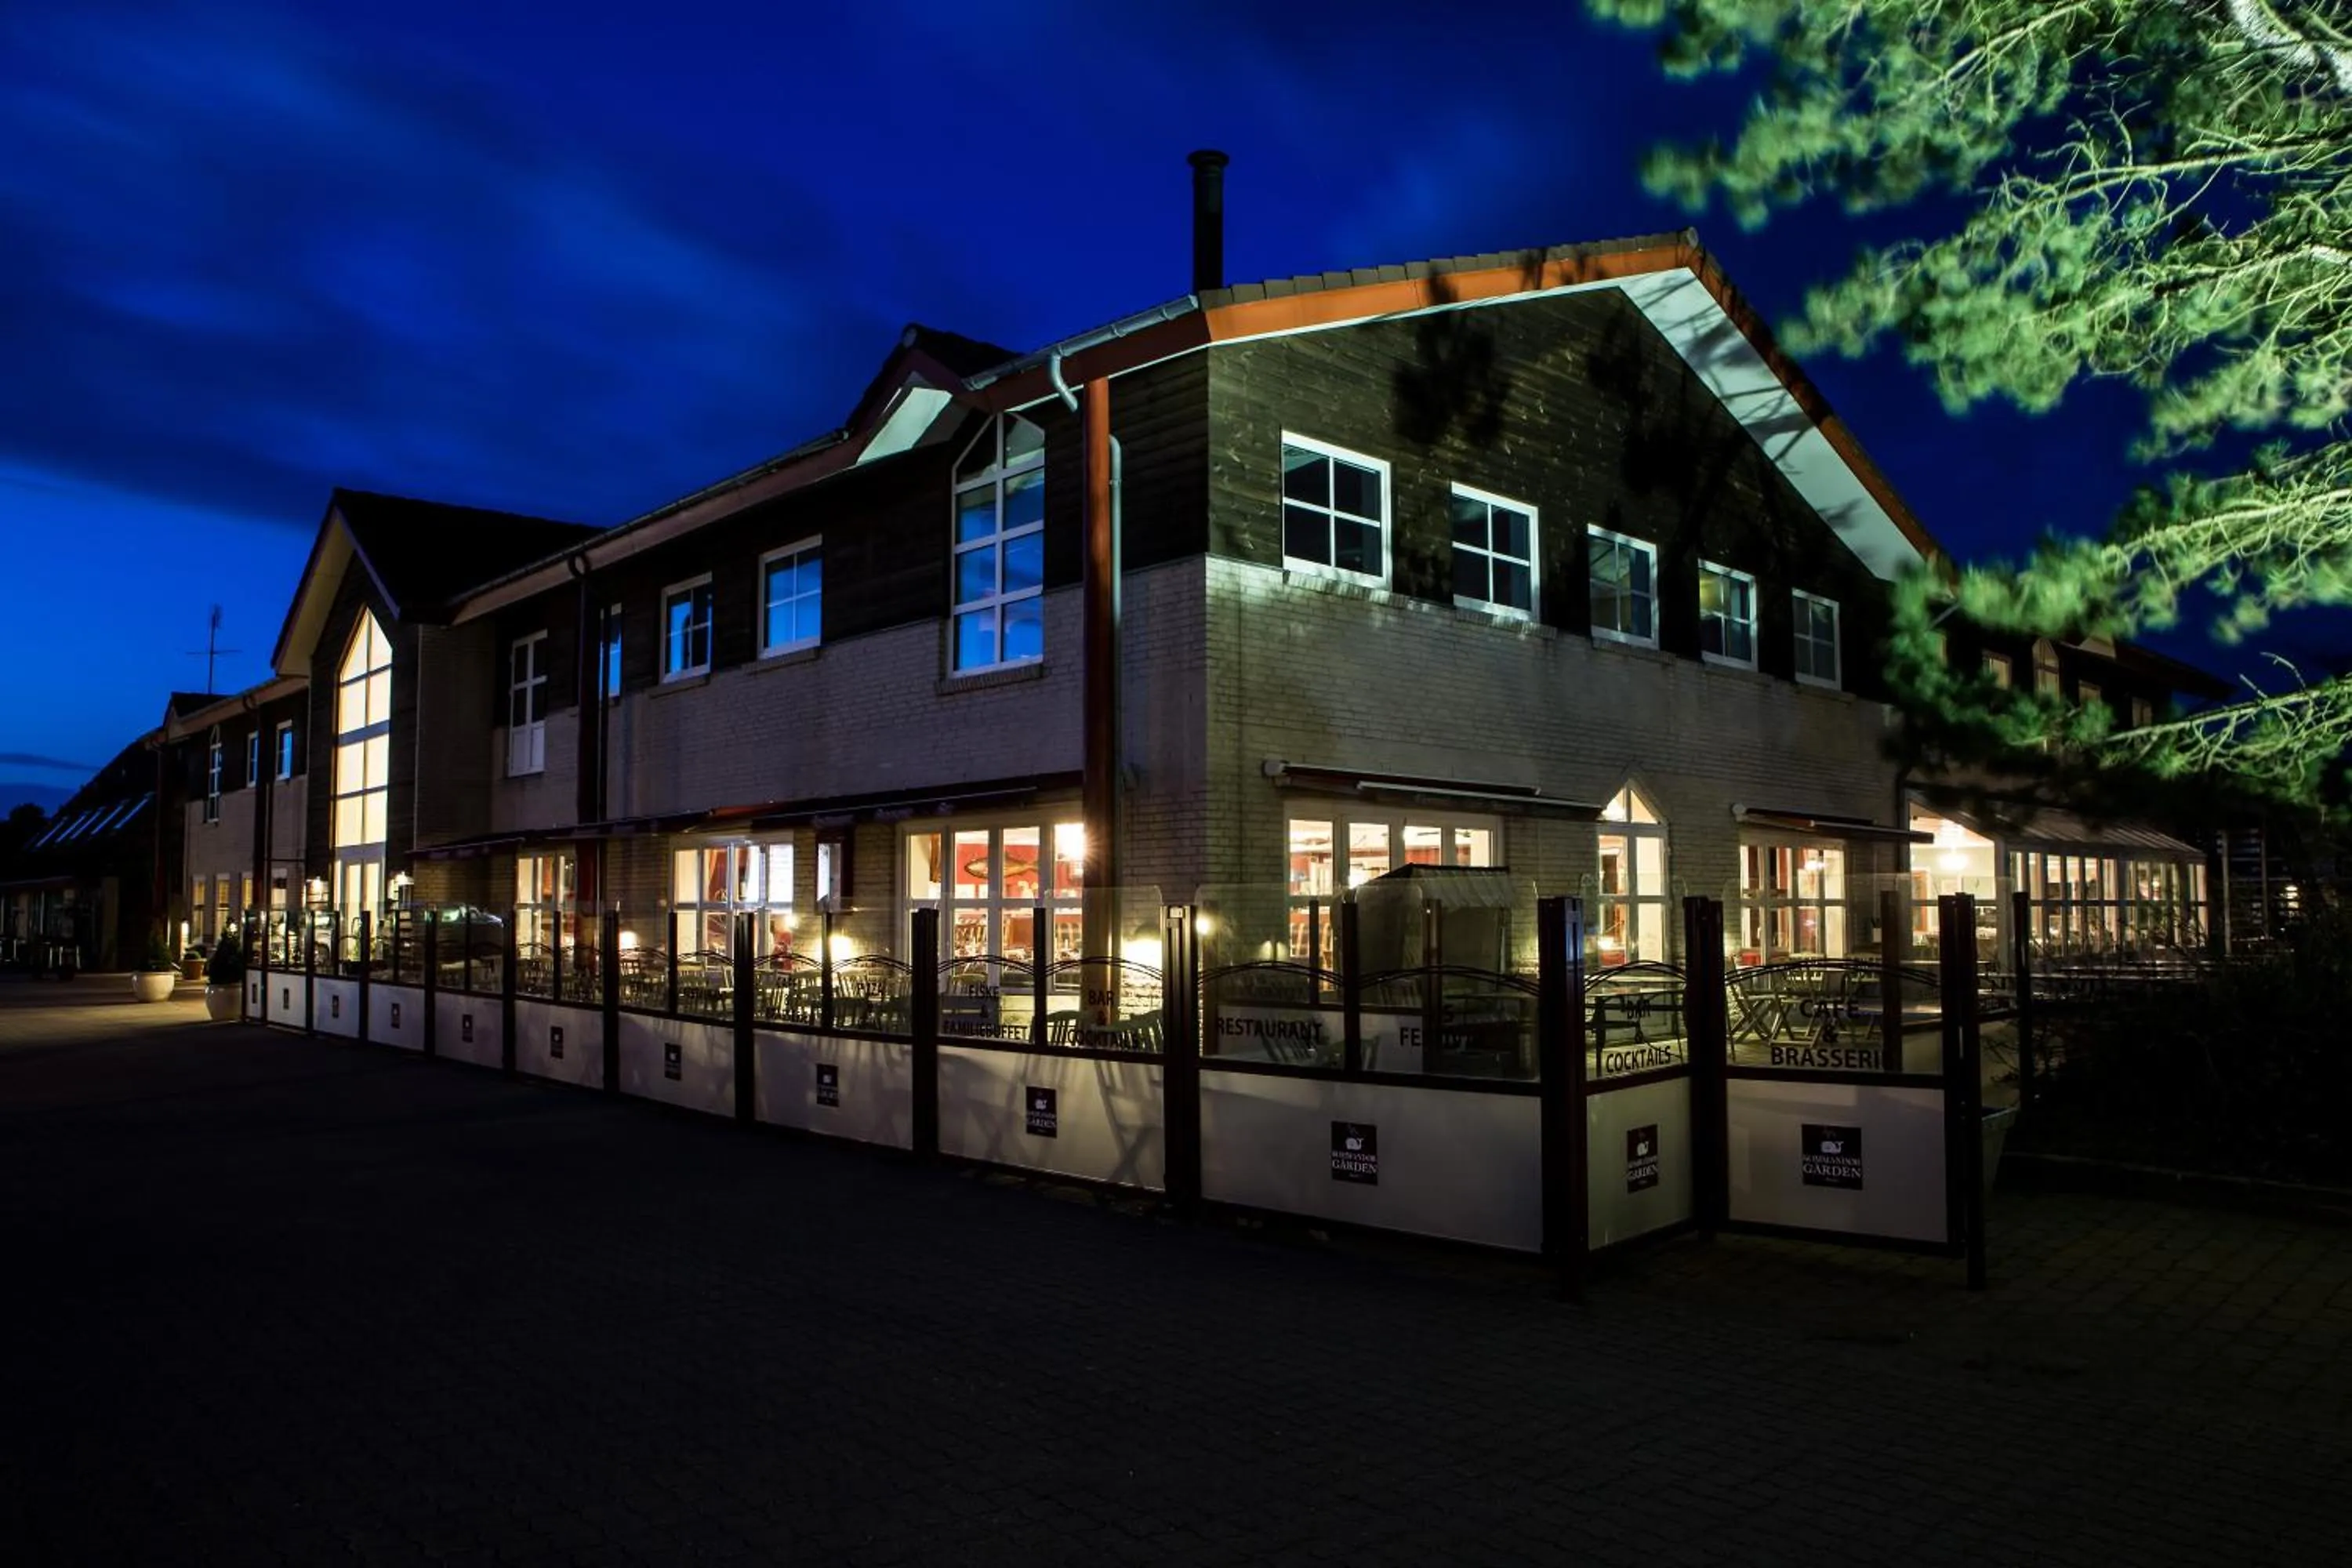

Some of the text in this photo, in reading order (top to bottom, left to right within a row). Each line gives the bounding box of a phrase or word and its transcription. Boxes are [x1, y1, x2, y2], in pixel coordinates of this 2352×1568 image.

[1087, 990, 1115, 1006] BAR
[1215, 1017, 1323, 1044] RESTAURANT
[1606, 1045, 1671, 1073] COCKTAILS
[1771, 1046, 1892, 1069] BRASSERI
